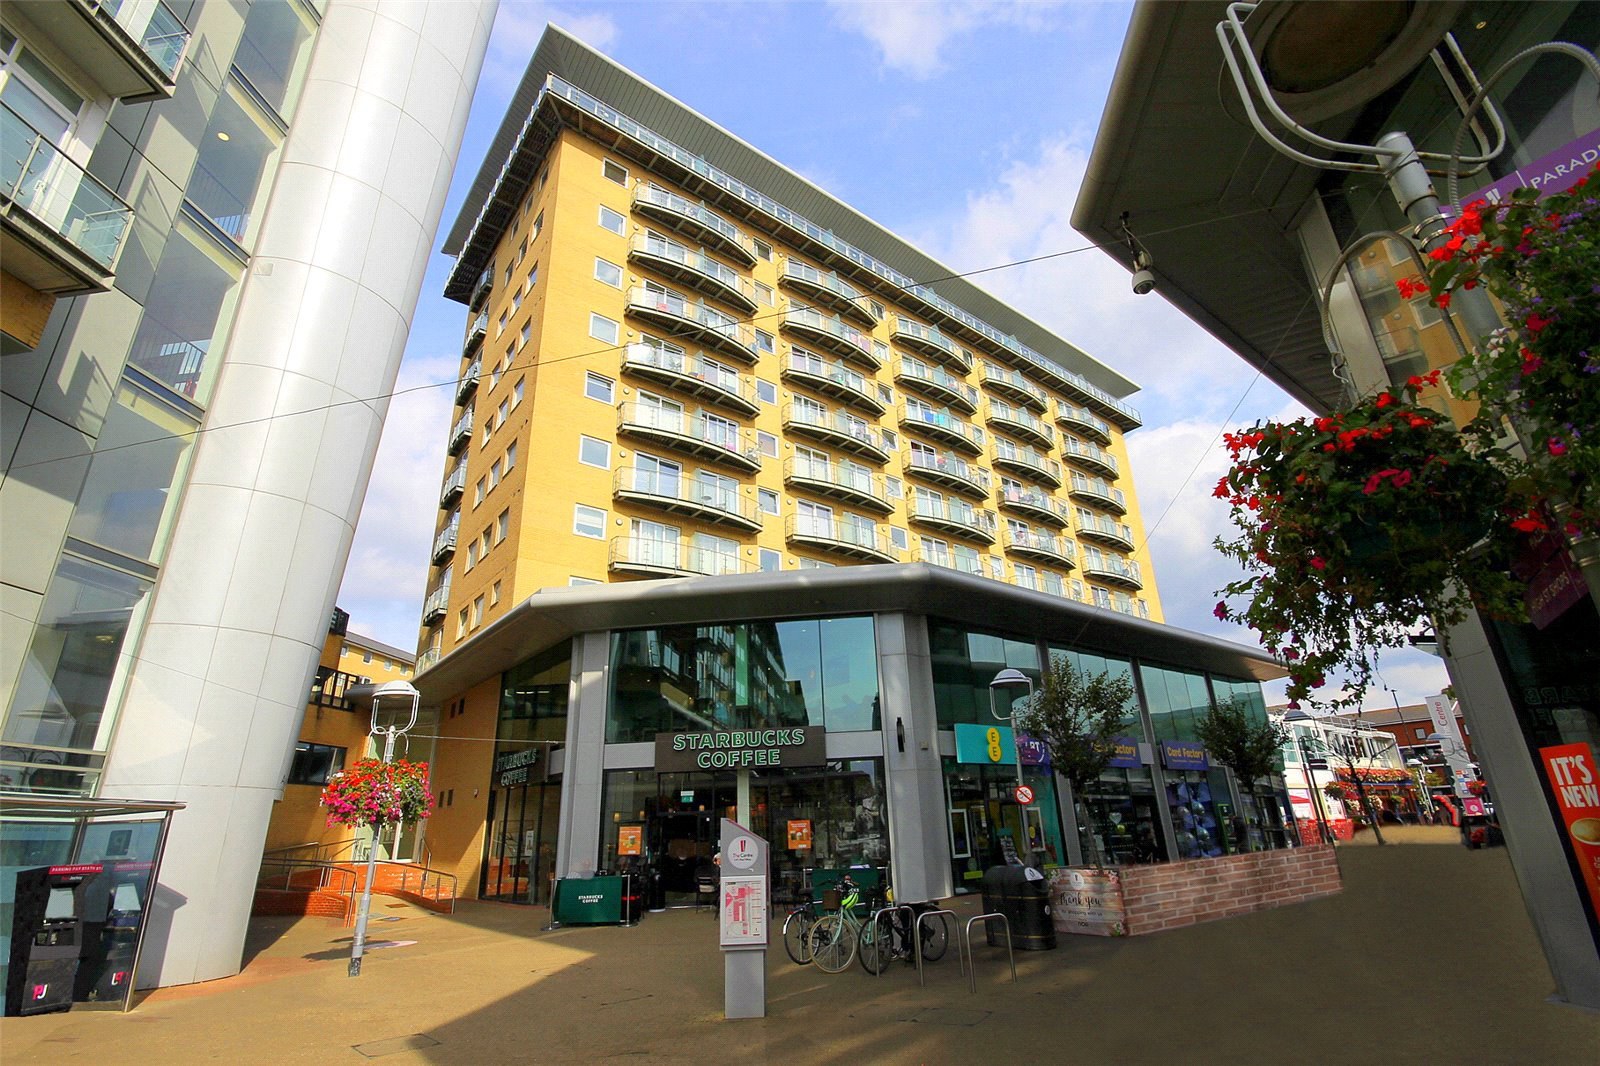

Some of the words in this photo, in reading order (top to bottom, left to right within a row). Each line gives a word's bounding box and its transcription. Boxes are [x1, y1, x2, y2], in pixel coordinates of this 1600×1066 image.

[1530, 144, 1600, 189] PARAD
[1434, 701, 1448, 727] Centre
[673, 729, 805, 751] STARBUCKS
[496, 748, 537, 772] STARBUCKS
[697, 748, 781, 768] COFFEE
[1167, 747, 1181, 757] Card
[1182, 748, 1204, 760] Factory
[501, 768, 528, 786] COFFEE
[1560, 784, 1600, 808] NEW
[1084, 894, 1103, 910] you
